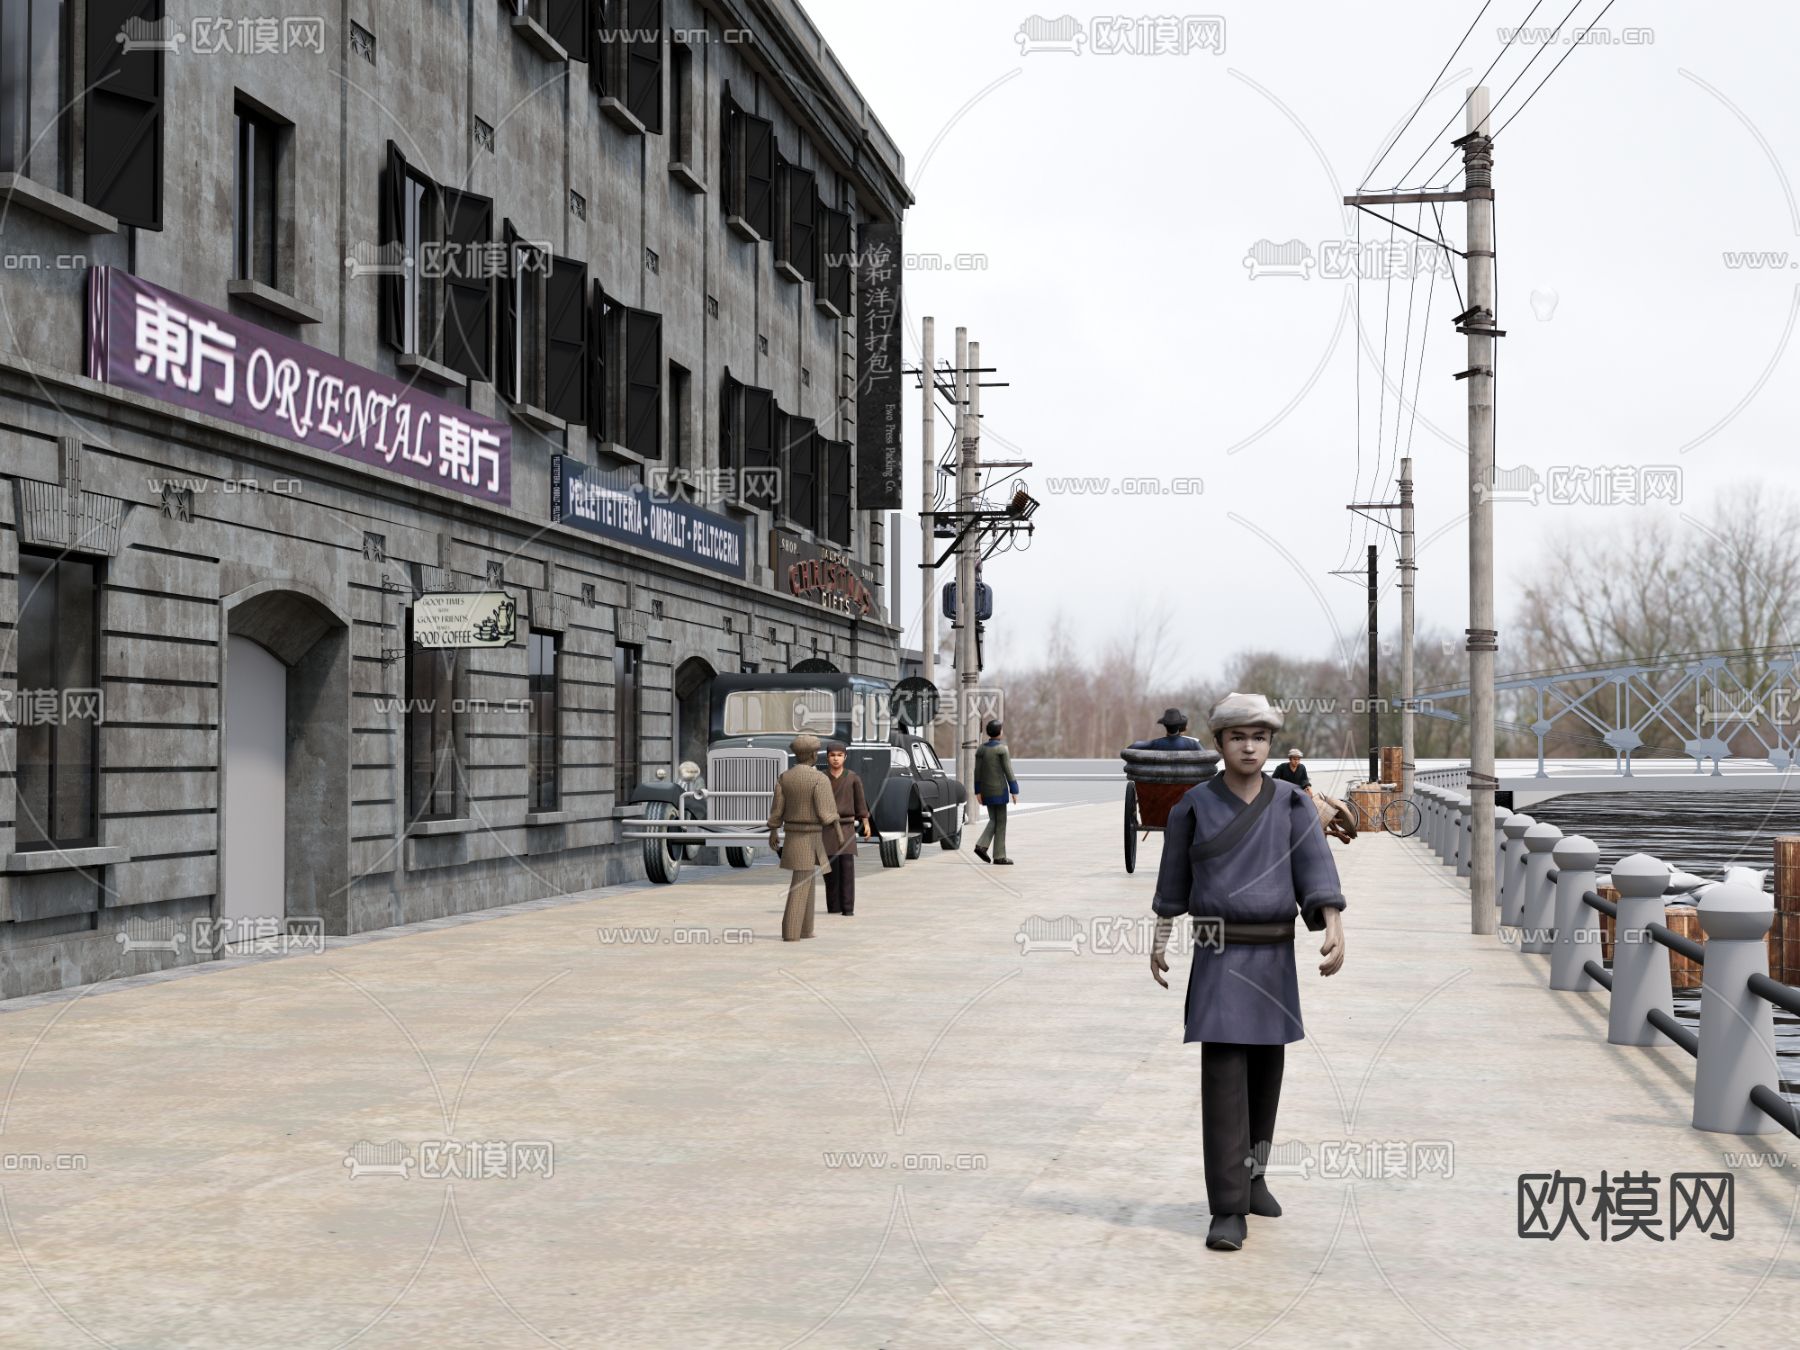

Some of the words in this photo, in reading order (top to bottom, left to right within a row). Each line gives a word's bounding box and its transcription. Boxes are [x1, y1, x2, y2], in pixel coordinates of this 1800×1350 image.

[864, 242, 894, 395] 怡和洋行打包厂
[134, 292, 236, 405] 東方
[246, 347, 433, 467] ORIENTAL
[439, 414, 500, 493] 東方
[885, 424, 896, 444] Press
[882, 447, 897, 477] Packing
[822, 592, 851, 615] GIFTS
[442, 630, 472, 644] COFFEE
